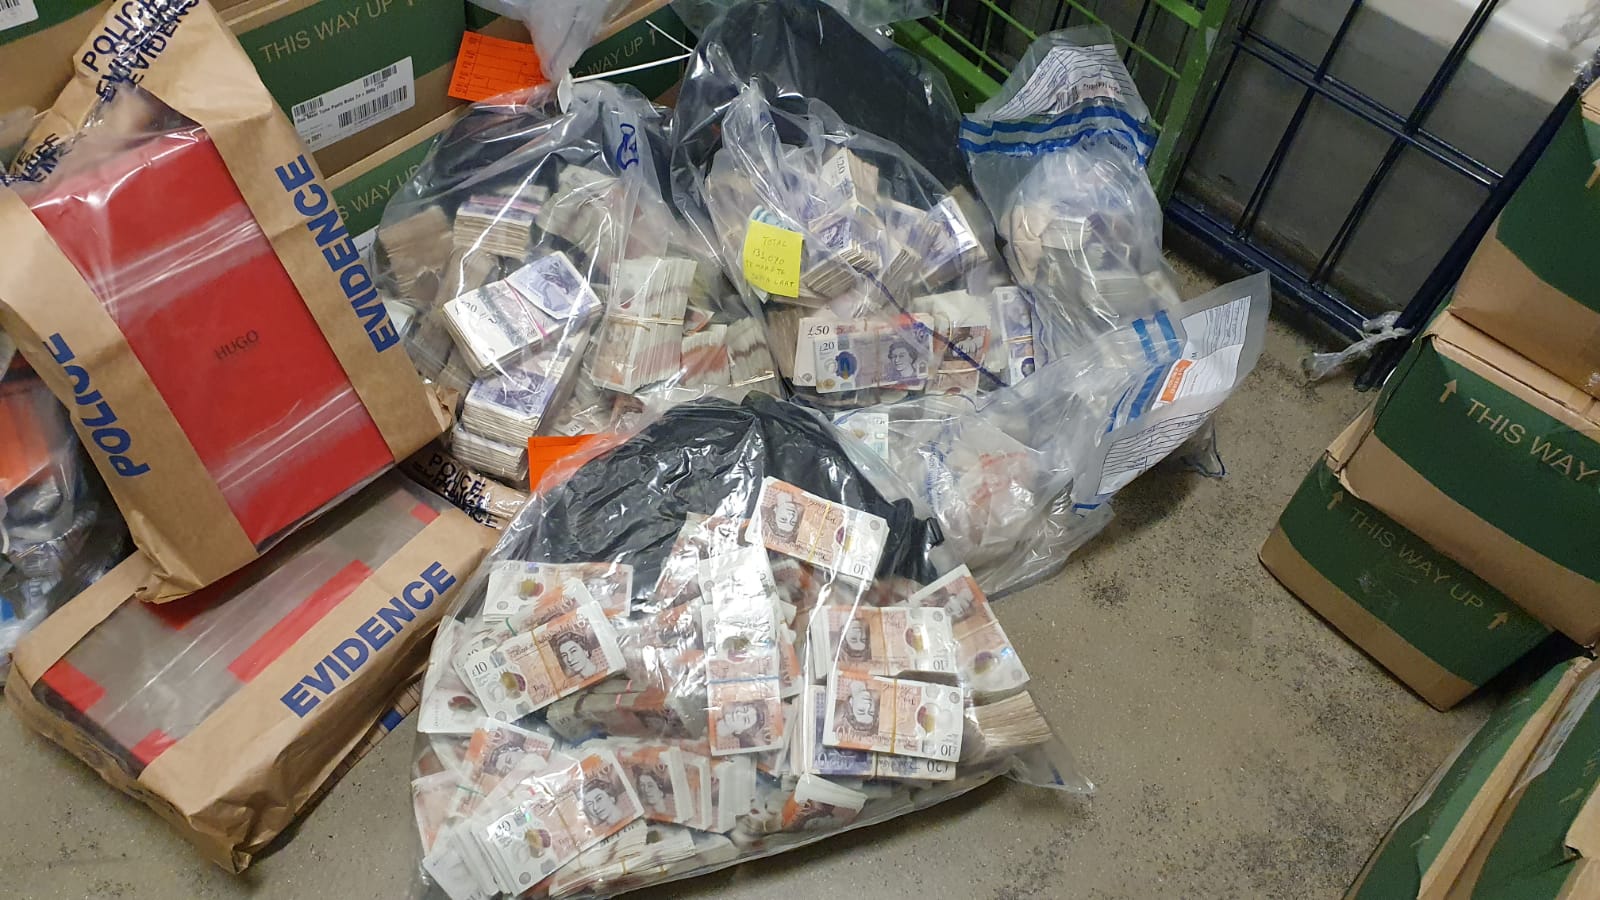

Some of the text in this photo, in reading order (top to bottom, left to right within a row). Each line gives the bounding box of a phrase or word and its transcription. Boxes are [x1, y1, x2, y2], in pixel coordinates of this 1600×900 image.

[258, 31, 311, 63] THIS
[314, 7, 360, 41] WAY
[588, 36, 643, 76] WAY UP
[351, 178, 392, 213] WAY
[274, 153, 401, 353] EVIDENCE
[214, 329, 259, 360] HUGO
[807, 325, 831, 337] £50
[1466, 397, 1599, 481] THIS WAY
[1350, 506, 1485, 610] THIS WAY UP
[279, 560, 457, 719] EVIDENCE
[471, 661, 488, 677] £10
